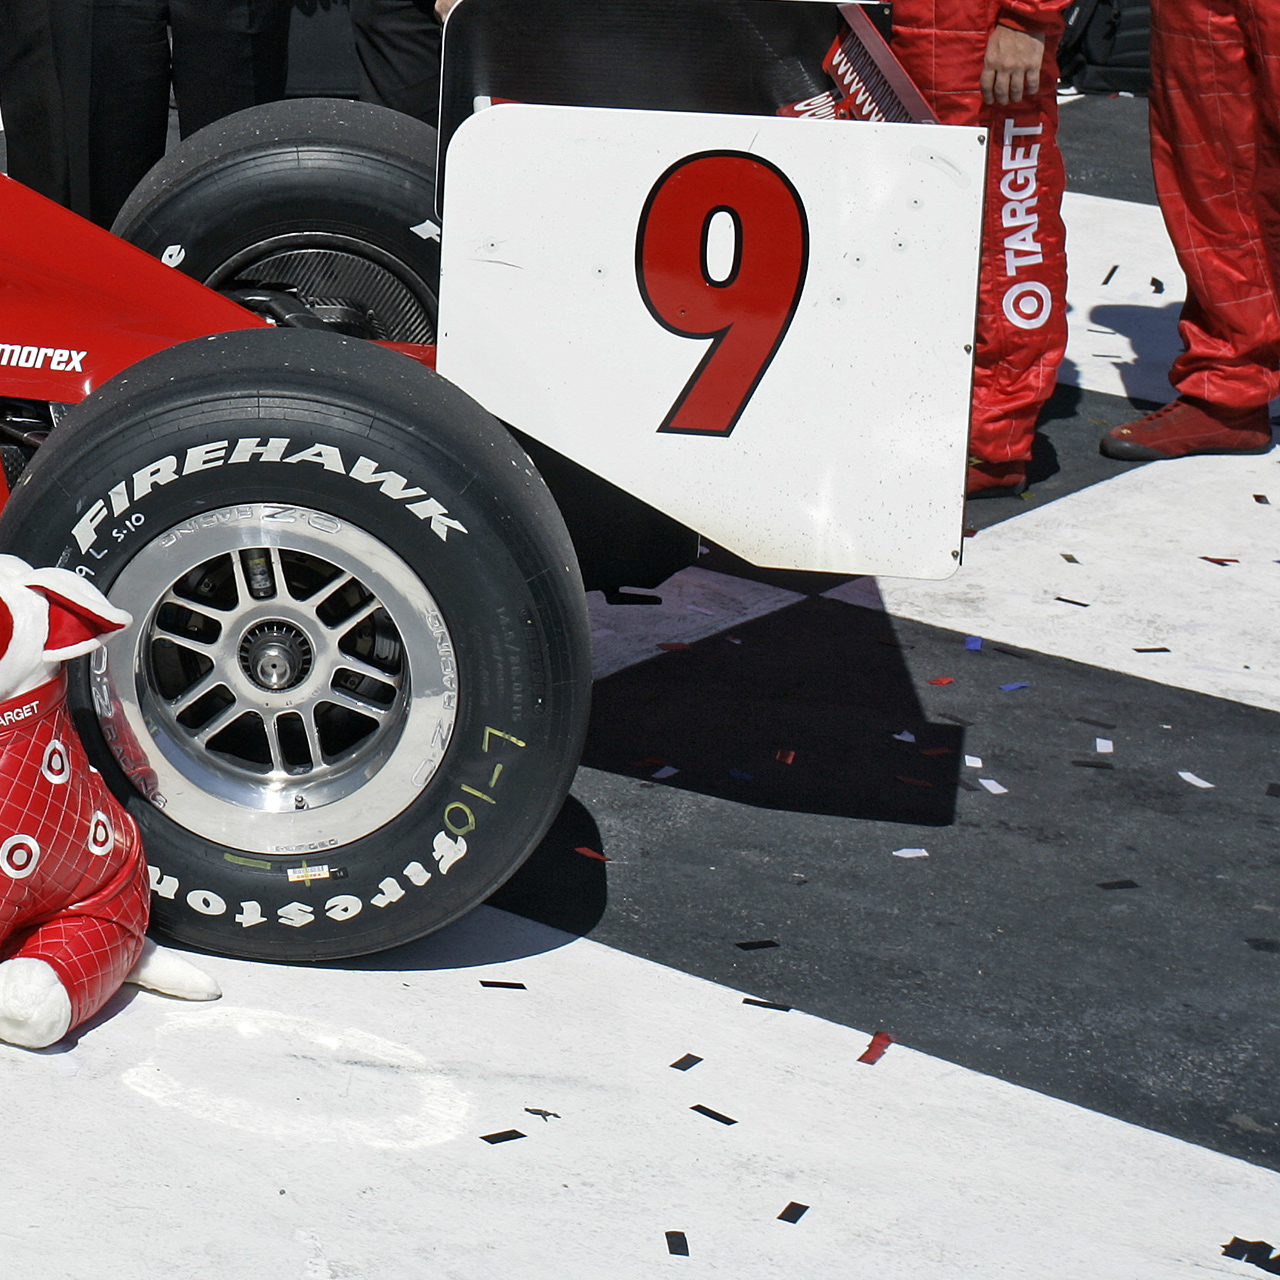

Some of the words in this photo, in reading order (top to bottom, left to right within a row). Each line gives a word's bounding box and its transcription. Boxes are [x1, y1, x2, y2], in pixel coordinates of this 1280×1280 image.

[1000, 118, 1042, 277] TARGET
[634, 149, 810, 439] 9
[70, 437, 469, 556] FIREHAWK
